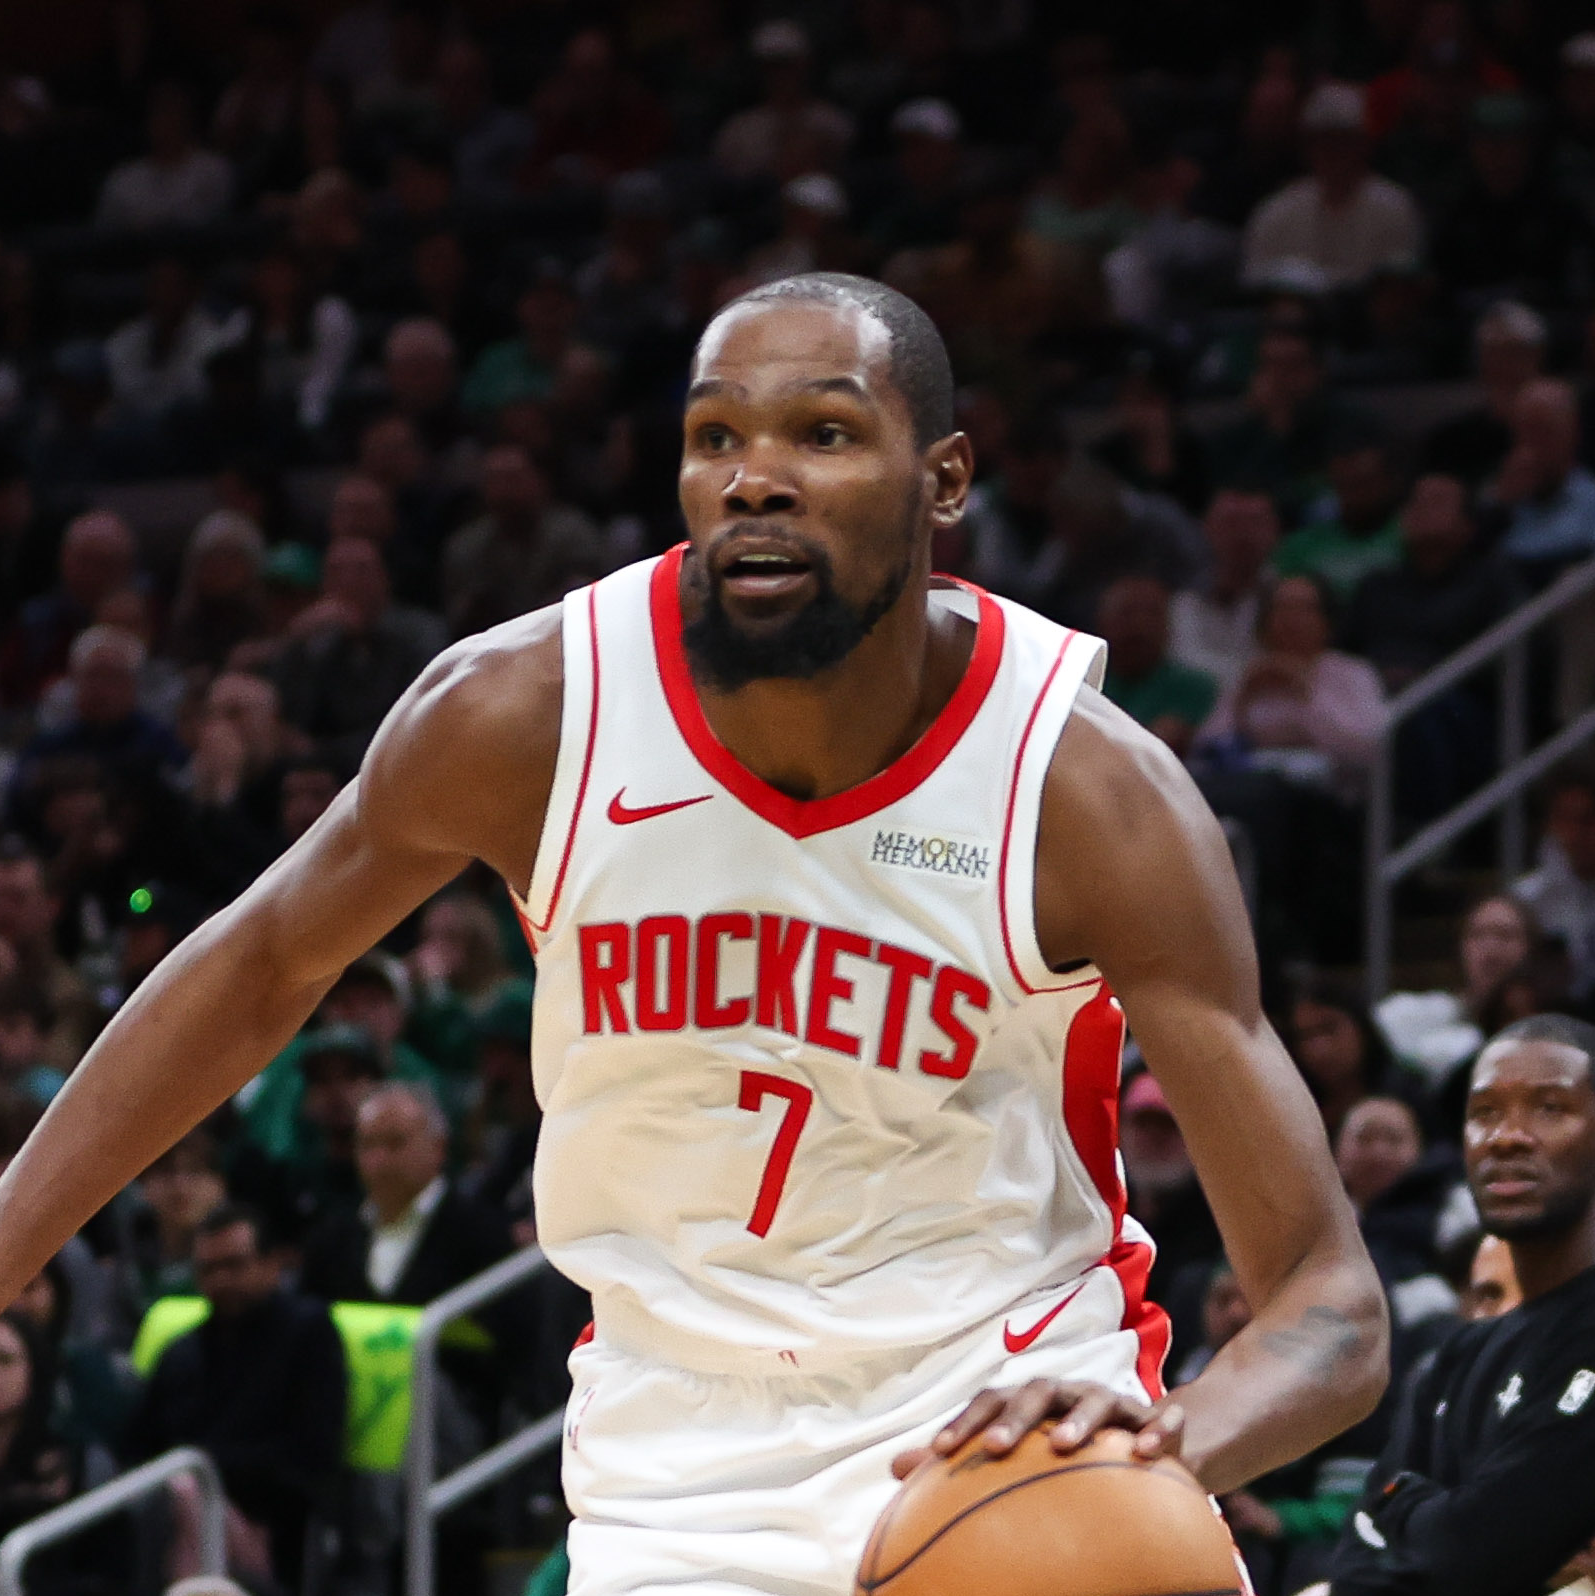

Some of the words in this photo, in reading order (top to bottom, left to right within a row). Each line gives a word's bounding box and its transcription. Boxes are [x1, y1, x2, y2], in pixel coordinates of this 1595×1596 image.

[871, 847, 991, 879] HERMANN
[874, 831, 990, 861] MEMORIAL
[578, 911, 992, 1081] ROCKETS
[736, 1070, 814, 1240] 7
